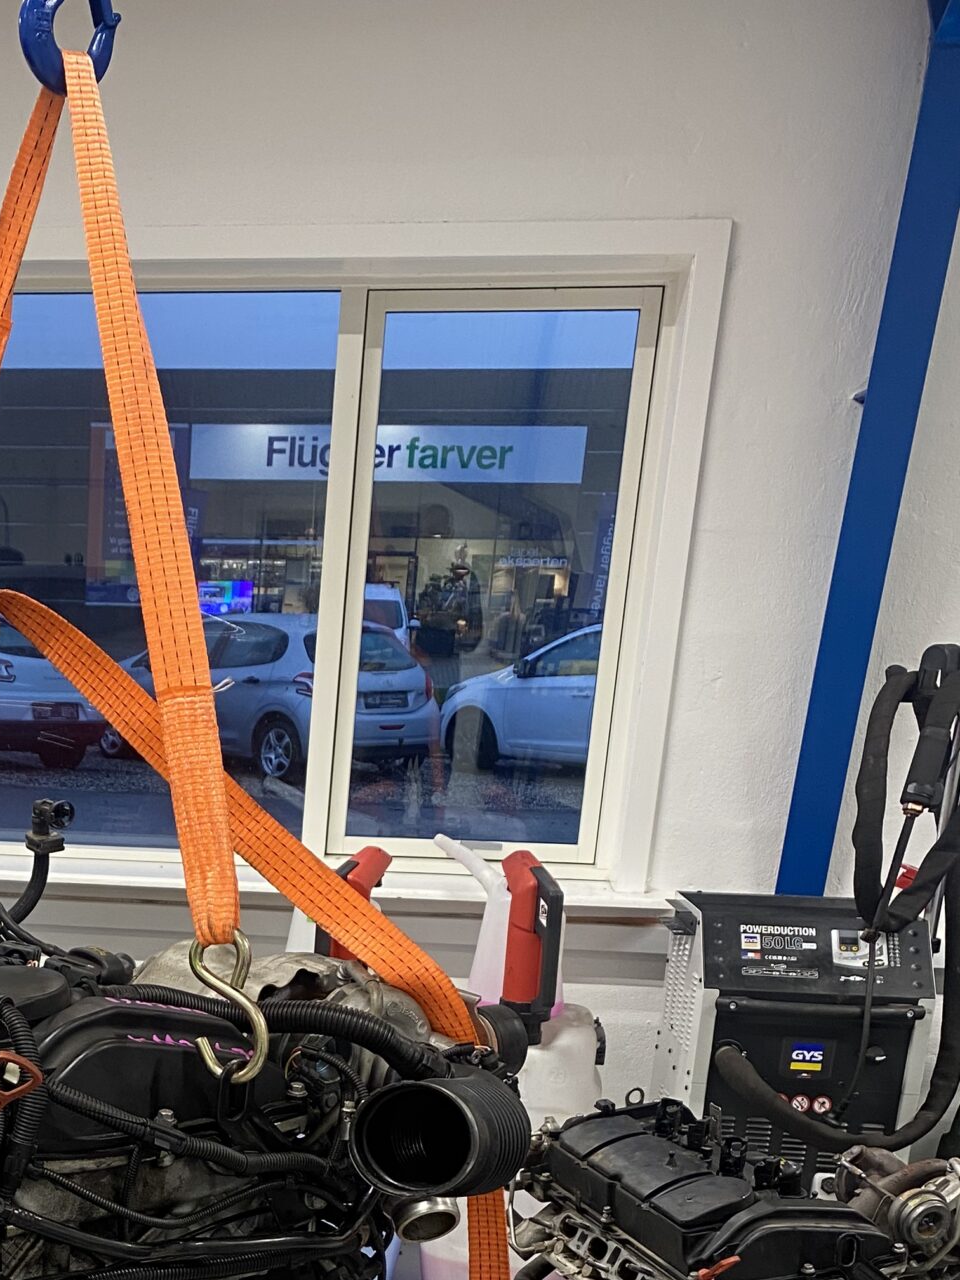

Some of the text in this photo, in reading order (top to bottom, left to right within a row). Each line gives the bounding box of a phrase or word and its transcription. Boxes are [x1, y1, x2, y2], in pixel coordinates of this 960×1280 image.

[406, 437, 514, 470] farver
[499, 556, 568, 568] eksperten
[740, 924, 817, 937] POWERDUCTION
[791, 1050, 823, 1061] GYS
